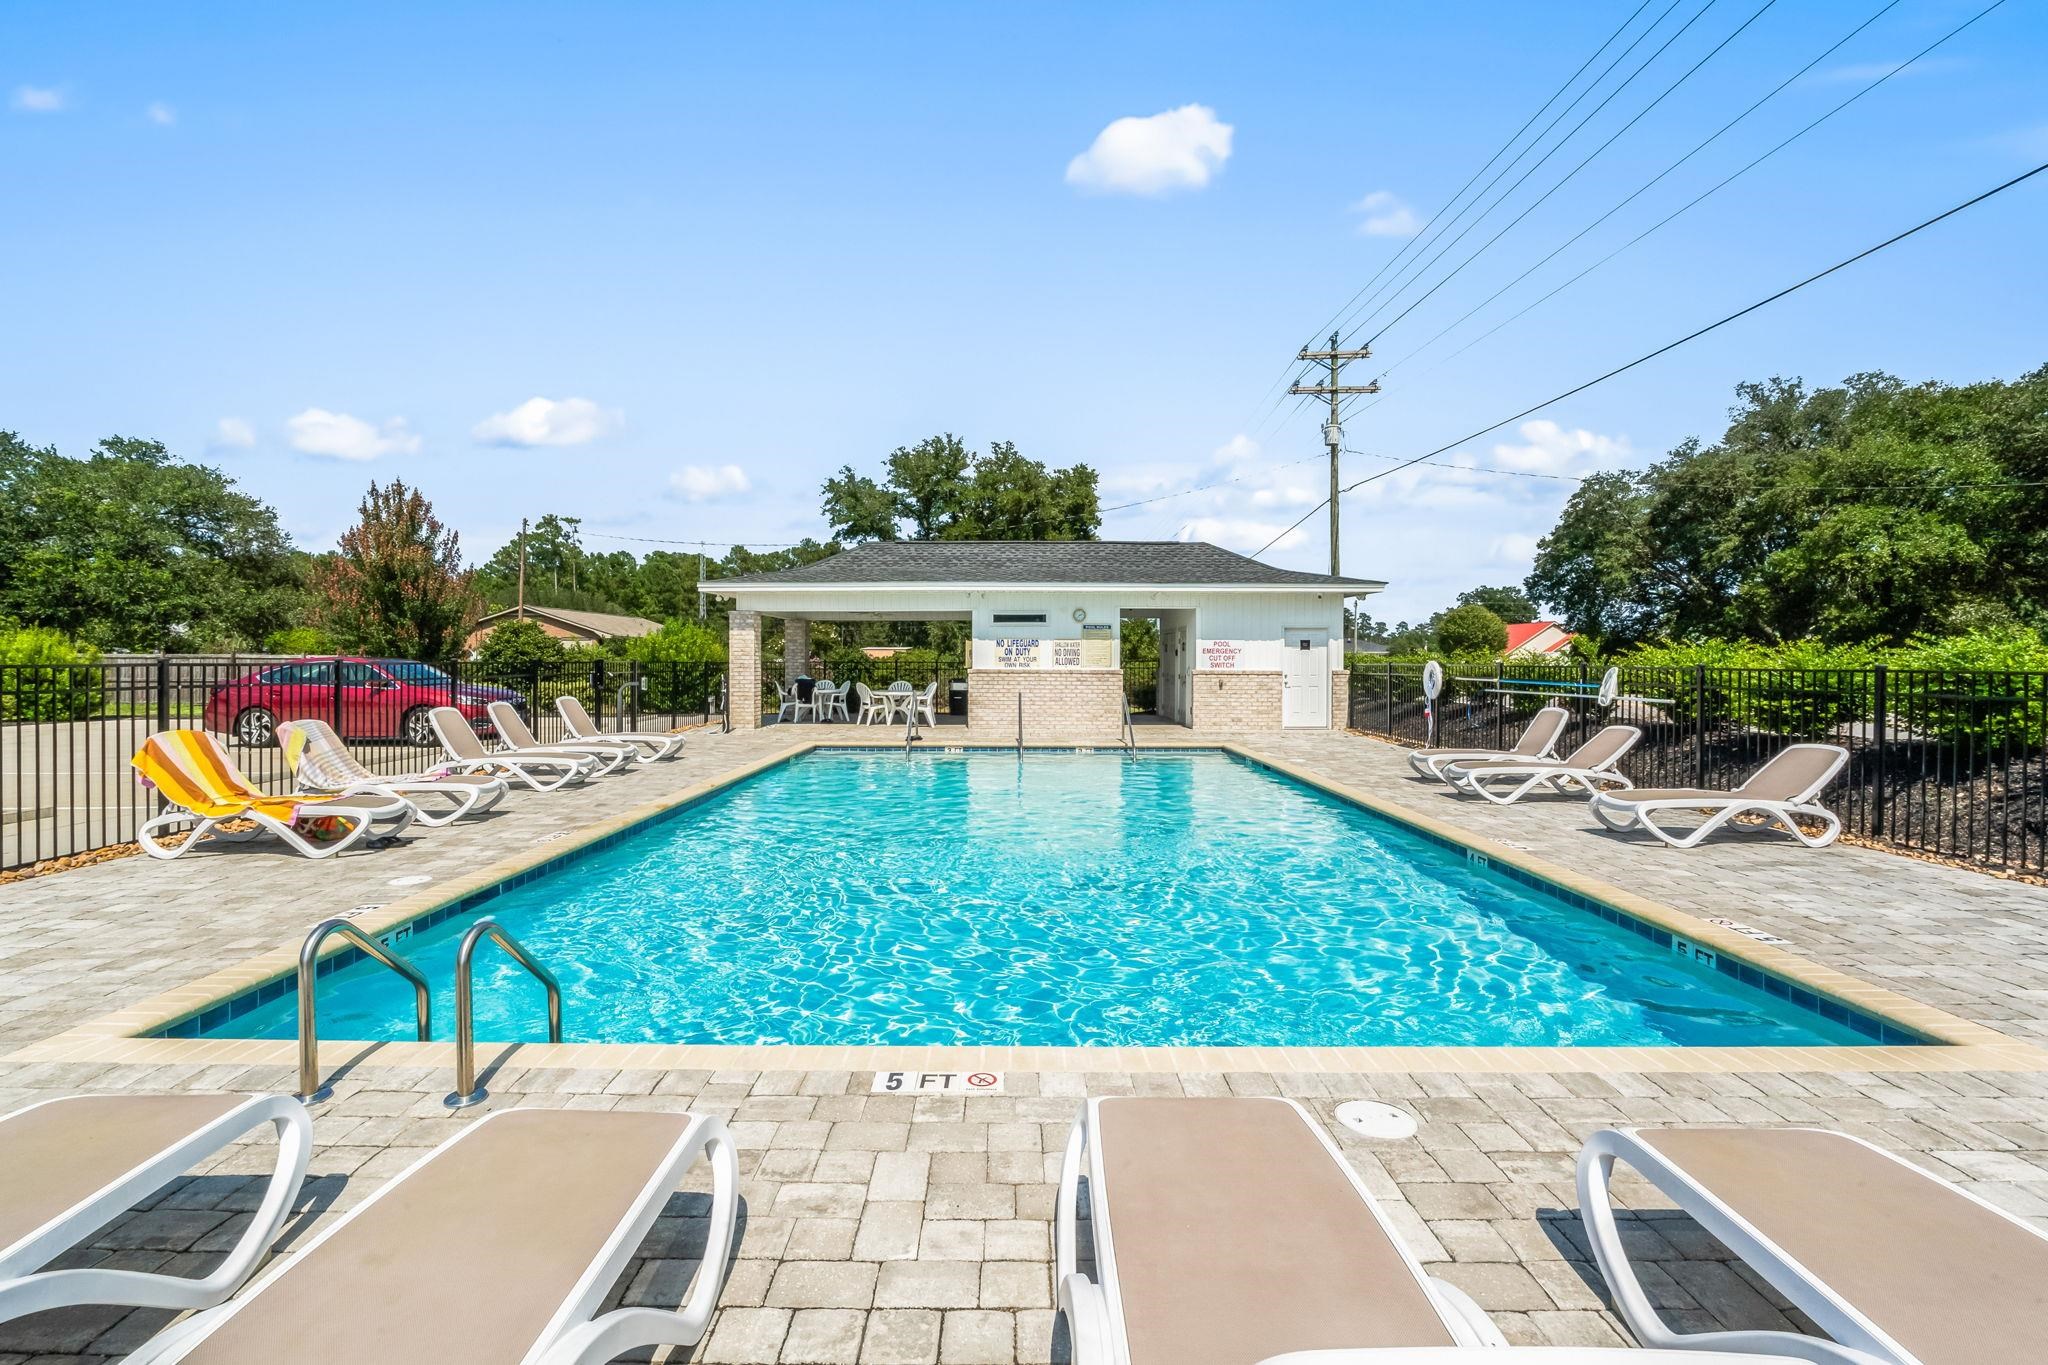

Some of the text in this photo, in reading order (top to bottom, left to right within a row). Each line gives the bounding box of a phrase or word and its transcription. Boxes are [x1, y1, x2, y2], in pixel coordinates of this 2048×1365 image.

[996, 639, 1039, 647] NO LIFEGUARD
[1004, 648, 1031, 656] ON DUTY
[1055, 657, 1080, 665] ALLOWED
[396, 926, 411, 942] FT
[1677, 940, 1714, 965] 5 FT
[885, 1072, 957, 1091] 5 FT
